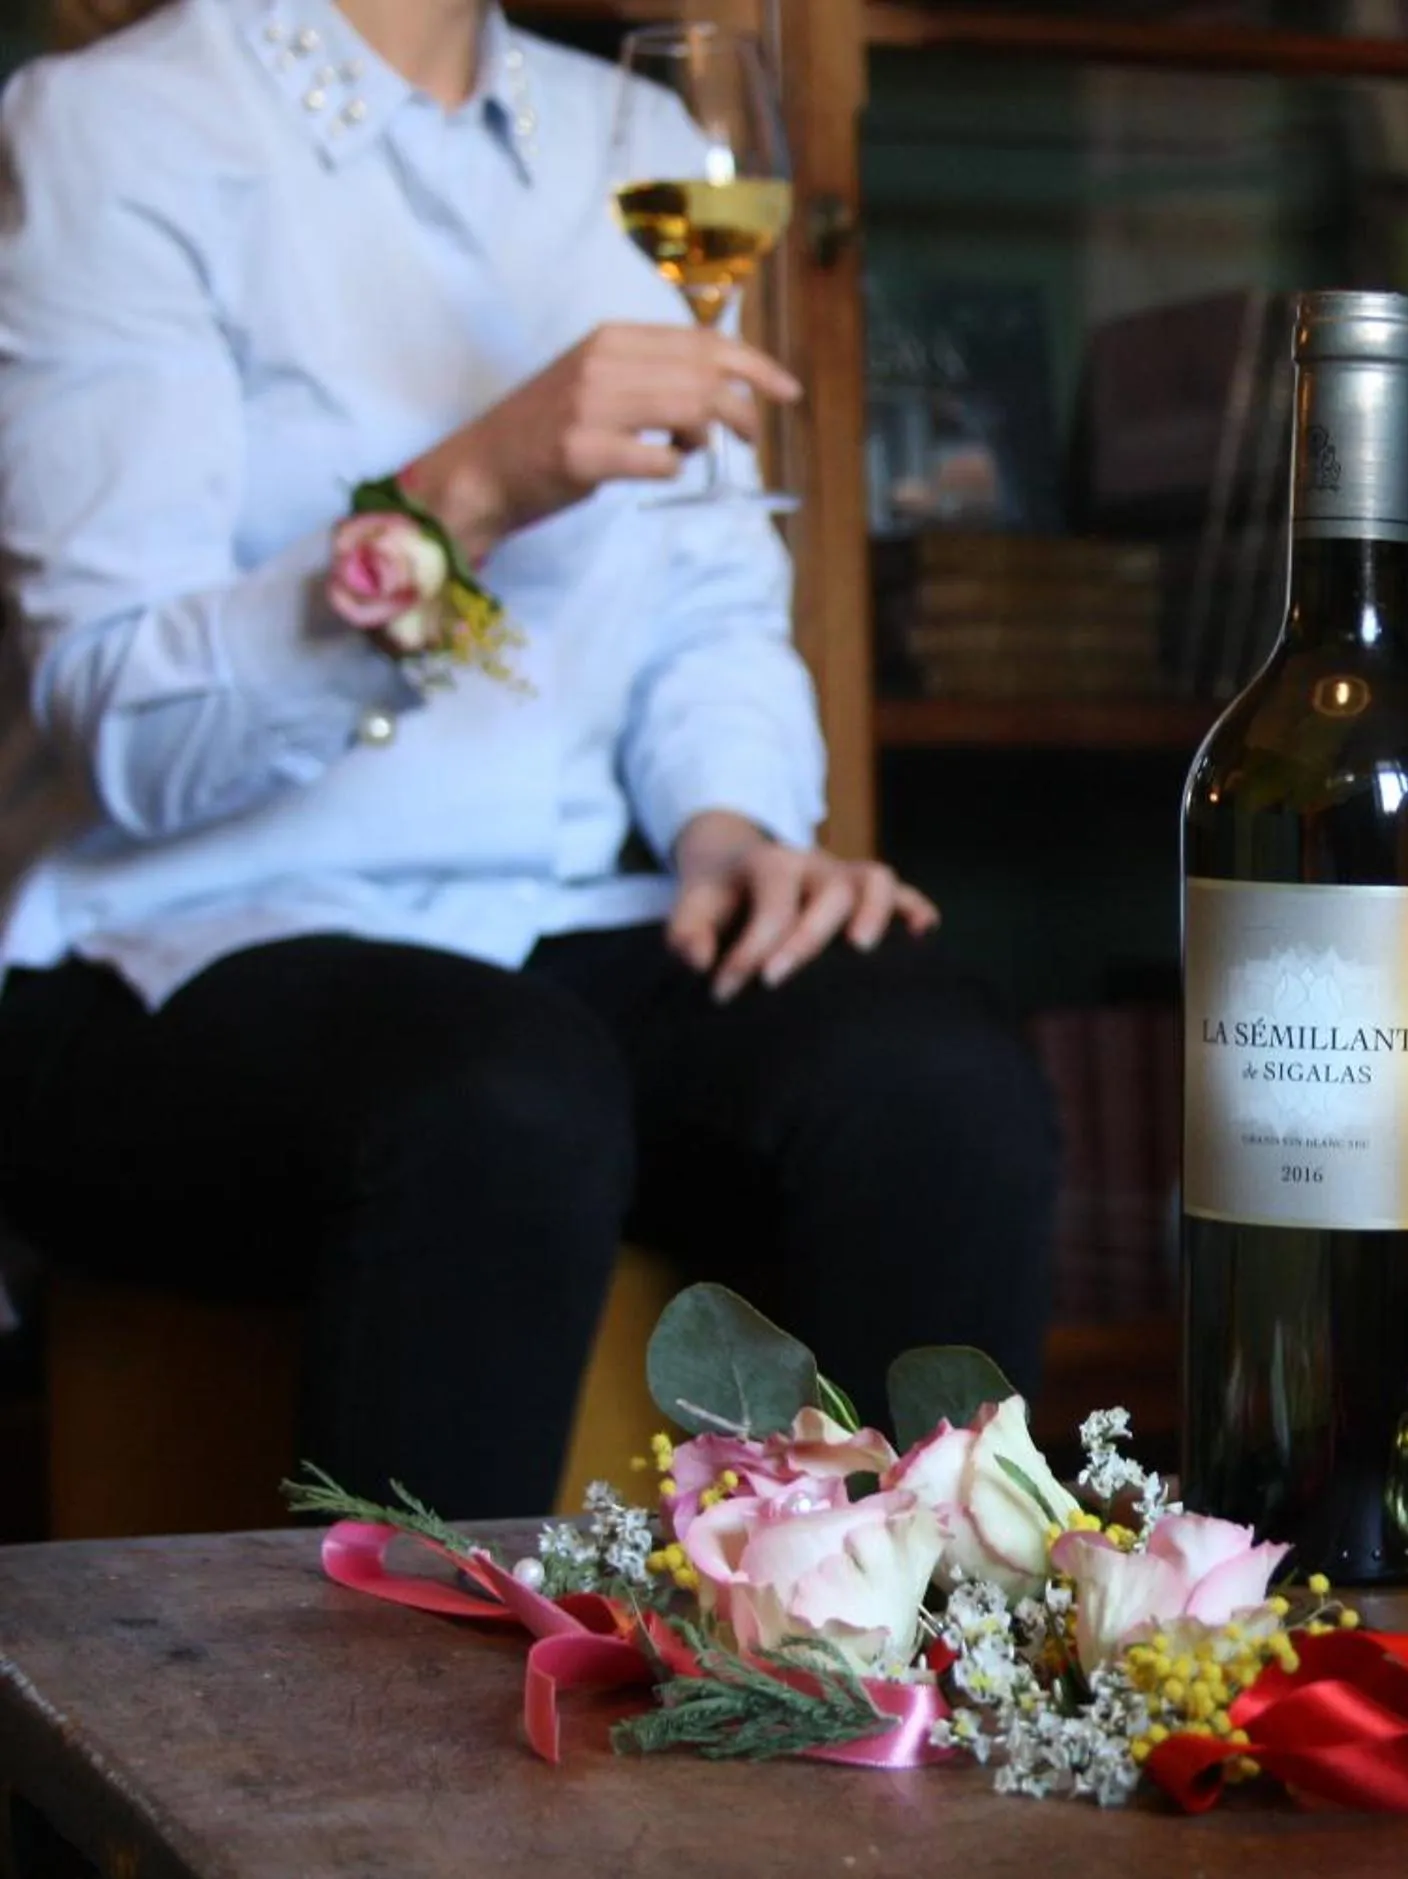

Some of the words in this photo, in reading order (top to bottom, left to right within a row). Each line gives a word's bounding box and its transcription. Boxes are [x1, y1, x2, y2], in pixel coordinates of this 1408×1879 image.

[1202, 1018, 1227, 1044] LA
[1263, 1062, 1372, 1084] SIGALAS
[1281, 1165, 1324, 1183] 2016
